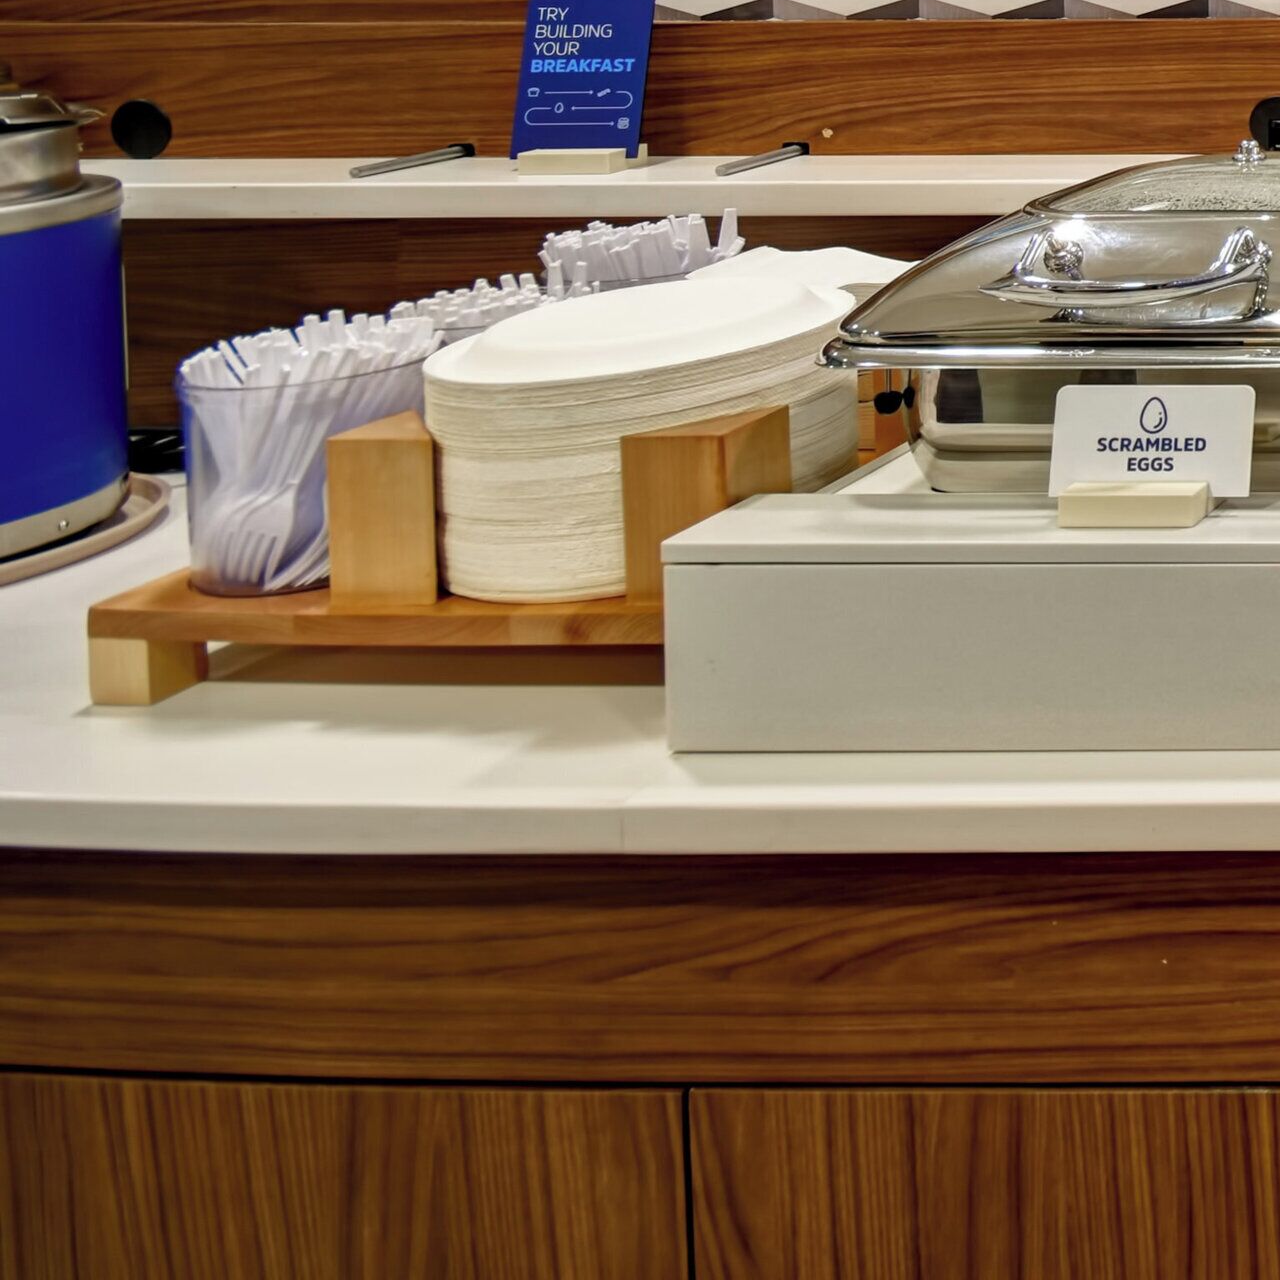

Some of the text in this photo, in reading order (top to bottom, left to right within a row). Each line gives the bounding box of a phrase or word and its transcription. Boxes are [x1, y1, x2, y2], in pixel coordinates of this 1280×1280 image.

[538, 7, 569, 21] TRY
[535, 24, 613, 39] BUILDING
[533, 42, 580, 56] YOUR
[530, 58, 636, 73] BREAKFAST
[1096, 437, 1207, 452] SCRAMBLED
[1127, 457, 1174, 472] EGGS
